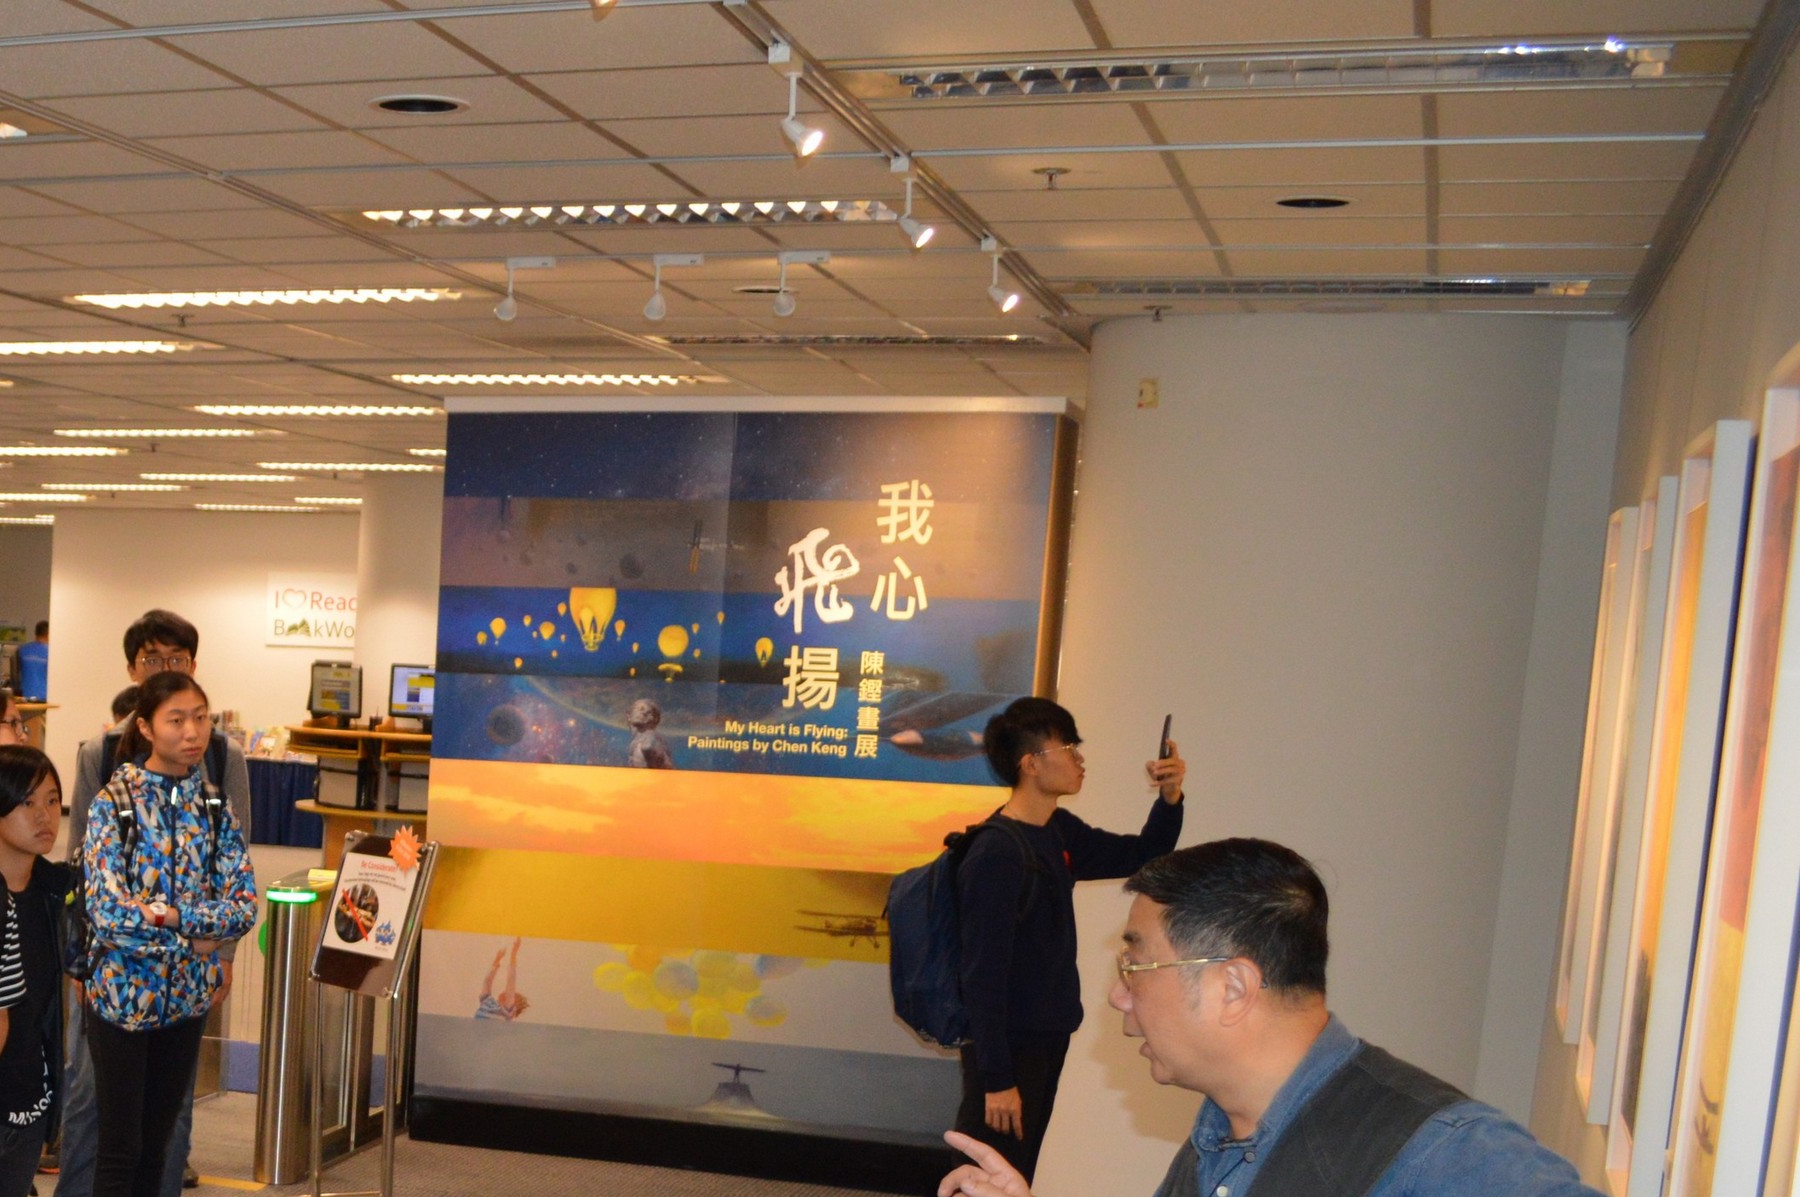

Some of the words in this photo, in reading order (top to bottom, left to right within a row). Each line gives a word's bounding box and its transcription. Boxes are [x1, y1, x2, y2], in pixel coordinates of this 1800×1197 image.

[870, 479, 935, 621] 我心
[725, 721, 745, 735] My
[748, 721, 785, 735] Heart
[788, 723, 800, 735] is
[803, 724, 848, 739] Flying:
[687, 736, 749, 753] Paintings
[752, 738, 769, 753] by
[772, 739, 807, 753] Chen
[811, 742, 847, 757] Keng
